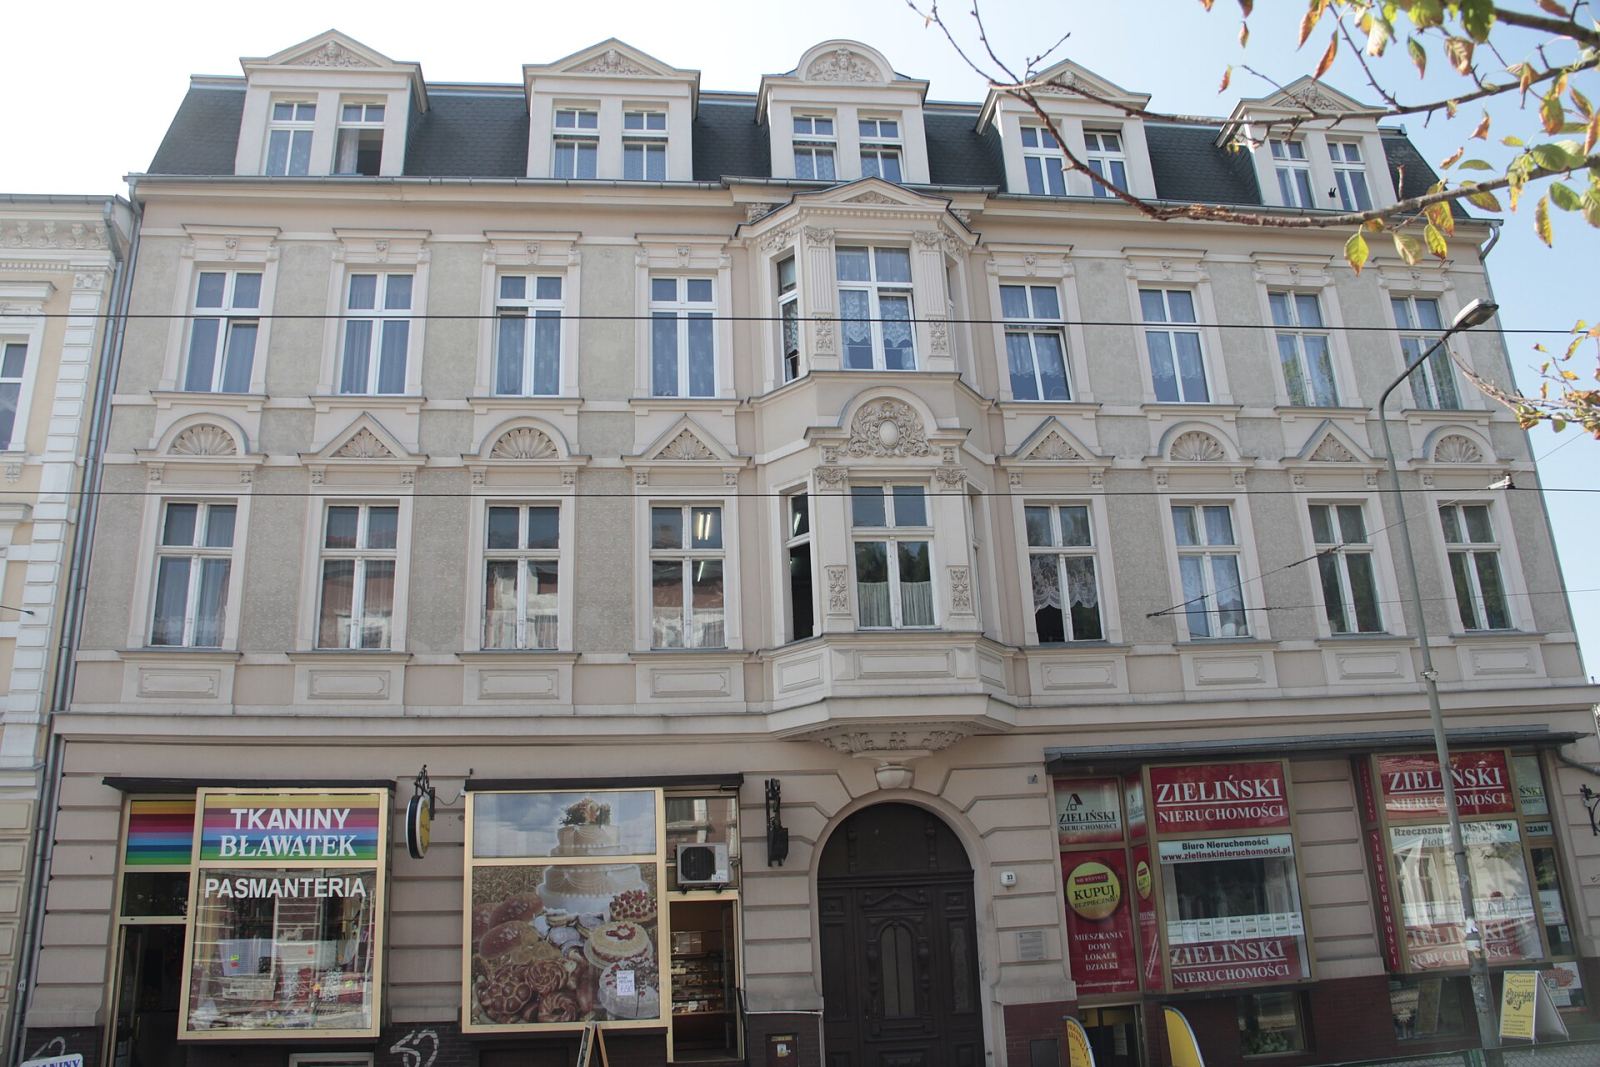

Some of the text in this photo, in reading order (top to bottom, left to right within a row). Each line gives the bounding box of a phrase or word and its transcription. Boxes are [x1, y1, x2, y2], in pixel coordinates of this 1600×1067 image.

[1389, 763, 1503, 791] ZIELŃSKI
[1157, 775, 1281, 803] ZIELIŃSKI
[1391, 790, 1506, 809] NIERUCOMOŚCI
[230, 808, 350, 830] TKANINY
[1059, 809, 1115, 823] ZIELIŃSKI
[1159, 802, 1284, 823] NIERUCHOMOŚCI
[219, 834, 357, 857] BŁAWATEK
[1161, 846, 1290, 861] www.zielinskinieruchomosci.pl
[1182, 838, 1269, 851] Biuro Nieruchomości
[205, 878, 366, 898] PASMANTERIA
[1074, 885, 1115, 900] KUPUJ
[1074, 931, 1124, 941] MIESZKANIA
[1085, 952, 1117, 961] LOKALE
[1088, 943, 1112, 951] DOMY
[1169, 940, 1286, 965] ZIELIŃSKI
[1086, 962, 1119, 971] DZIAŁKI
[1173, 962, 1290, 984] NIERUCHOMOŚCI
